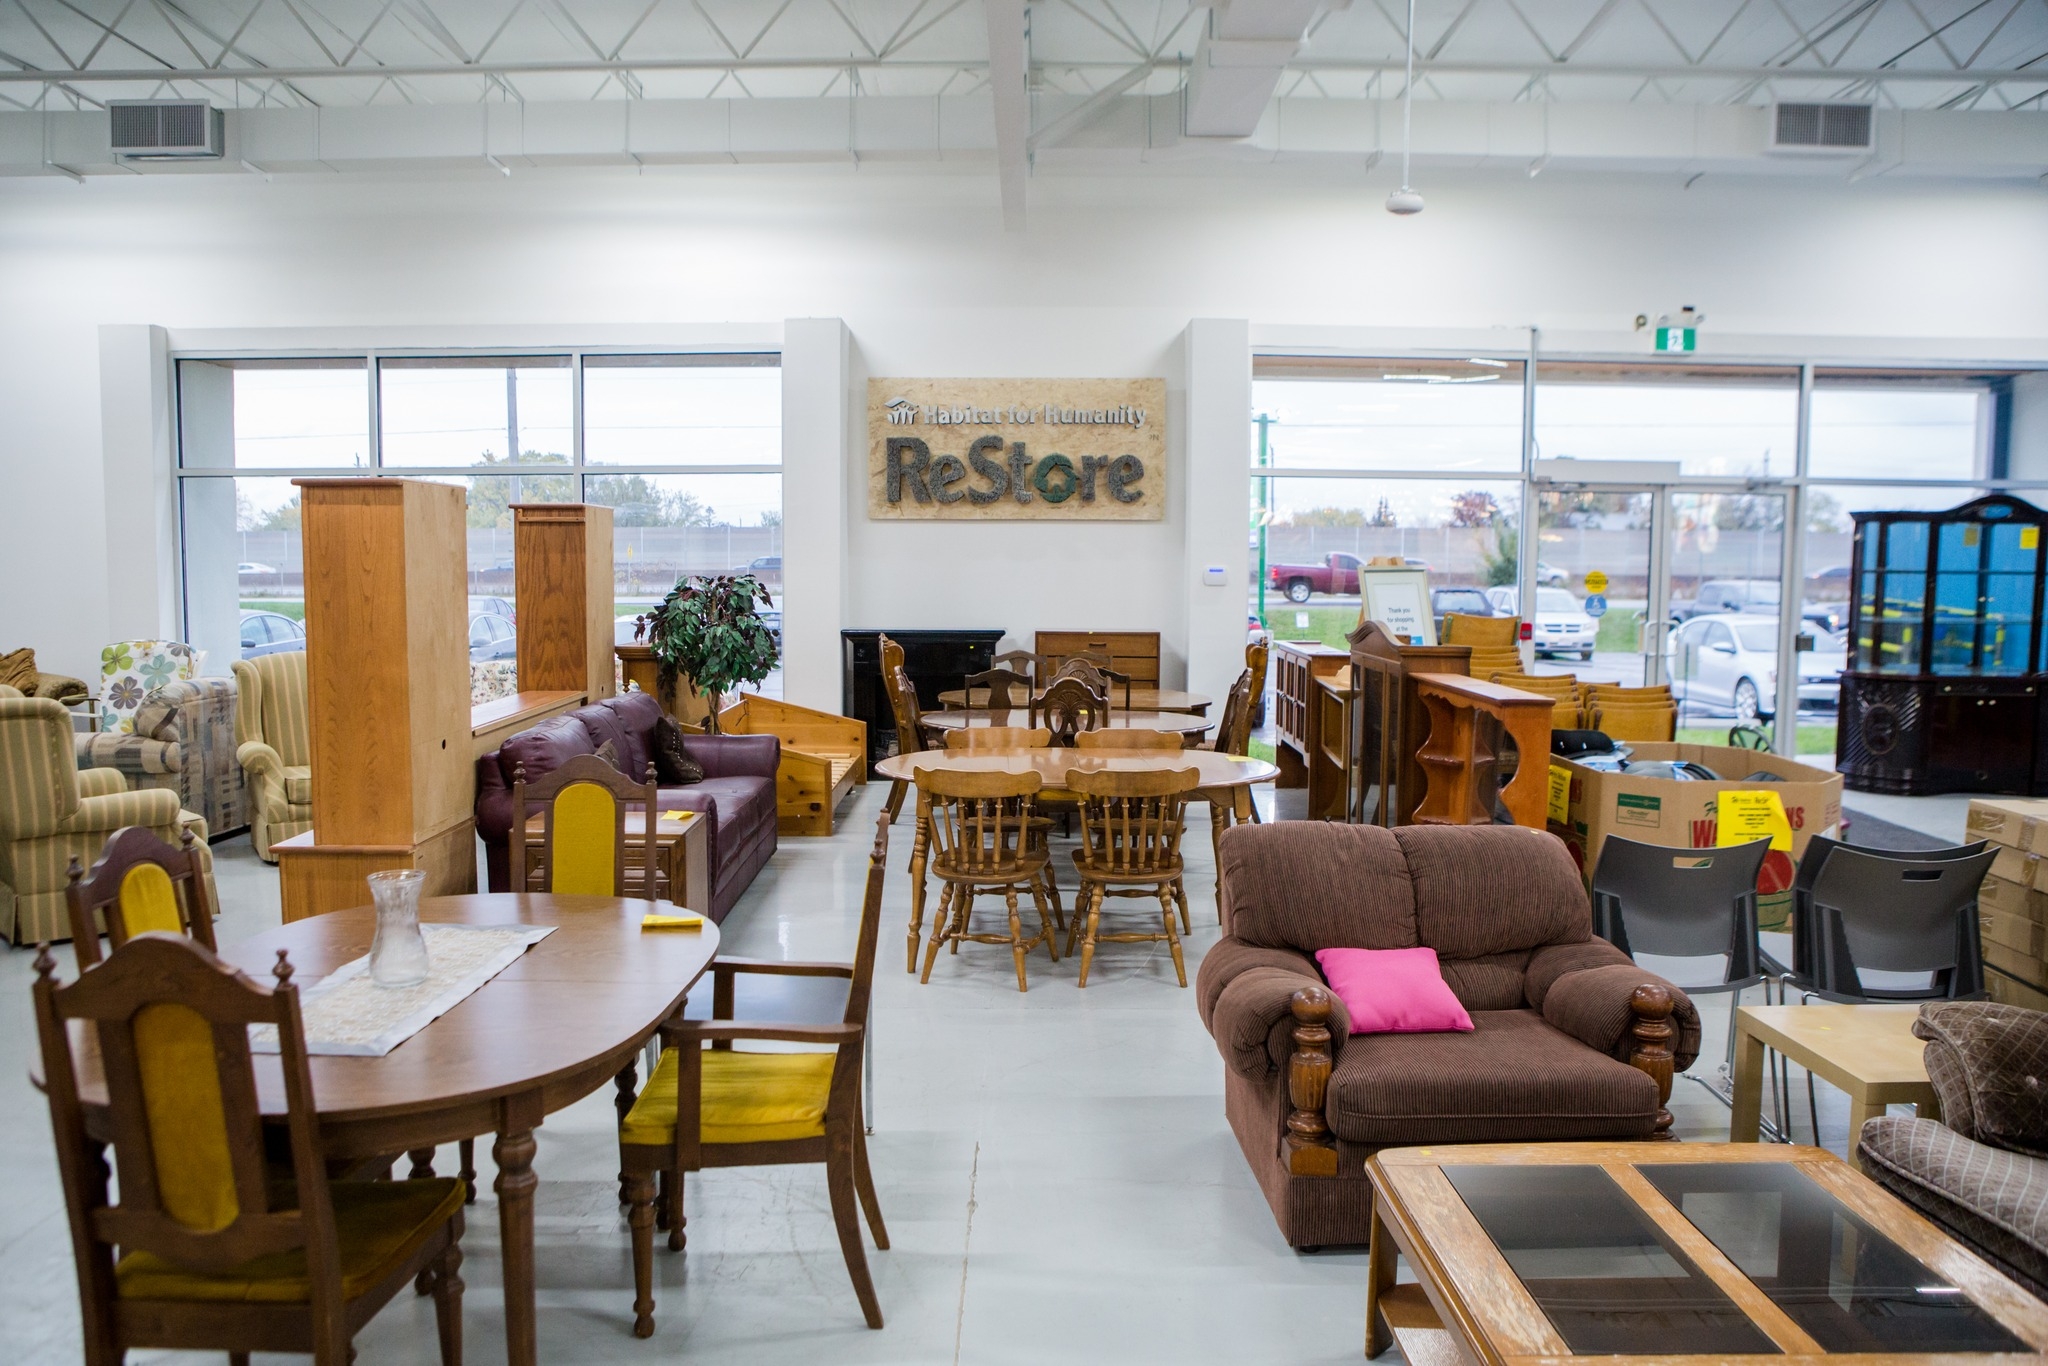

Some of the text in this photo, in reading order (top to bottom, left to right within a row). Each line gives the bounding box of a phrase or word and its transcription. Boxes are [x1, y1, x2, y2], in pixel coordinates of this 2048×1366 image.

[923, 404, 1147, 429] Habitat for Humanity
[886, 435, 1146, 504] ReStore
